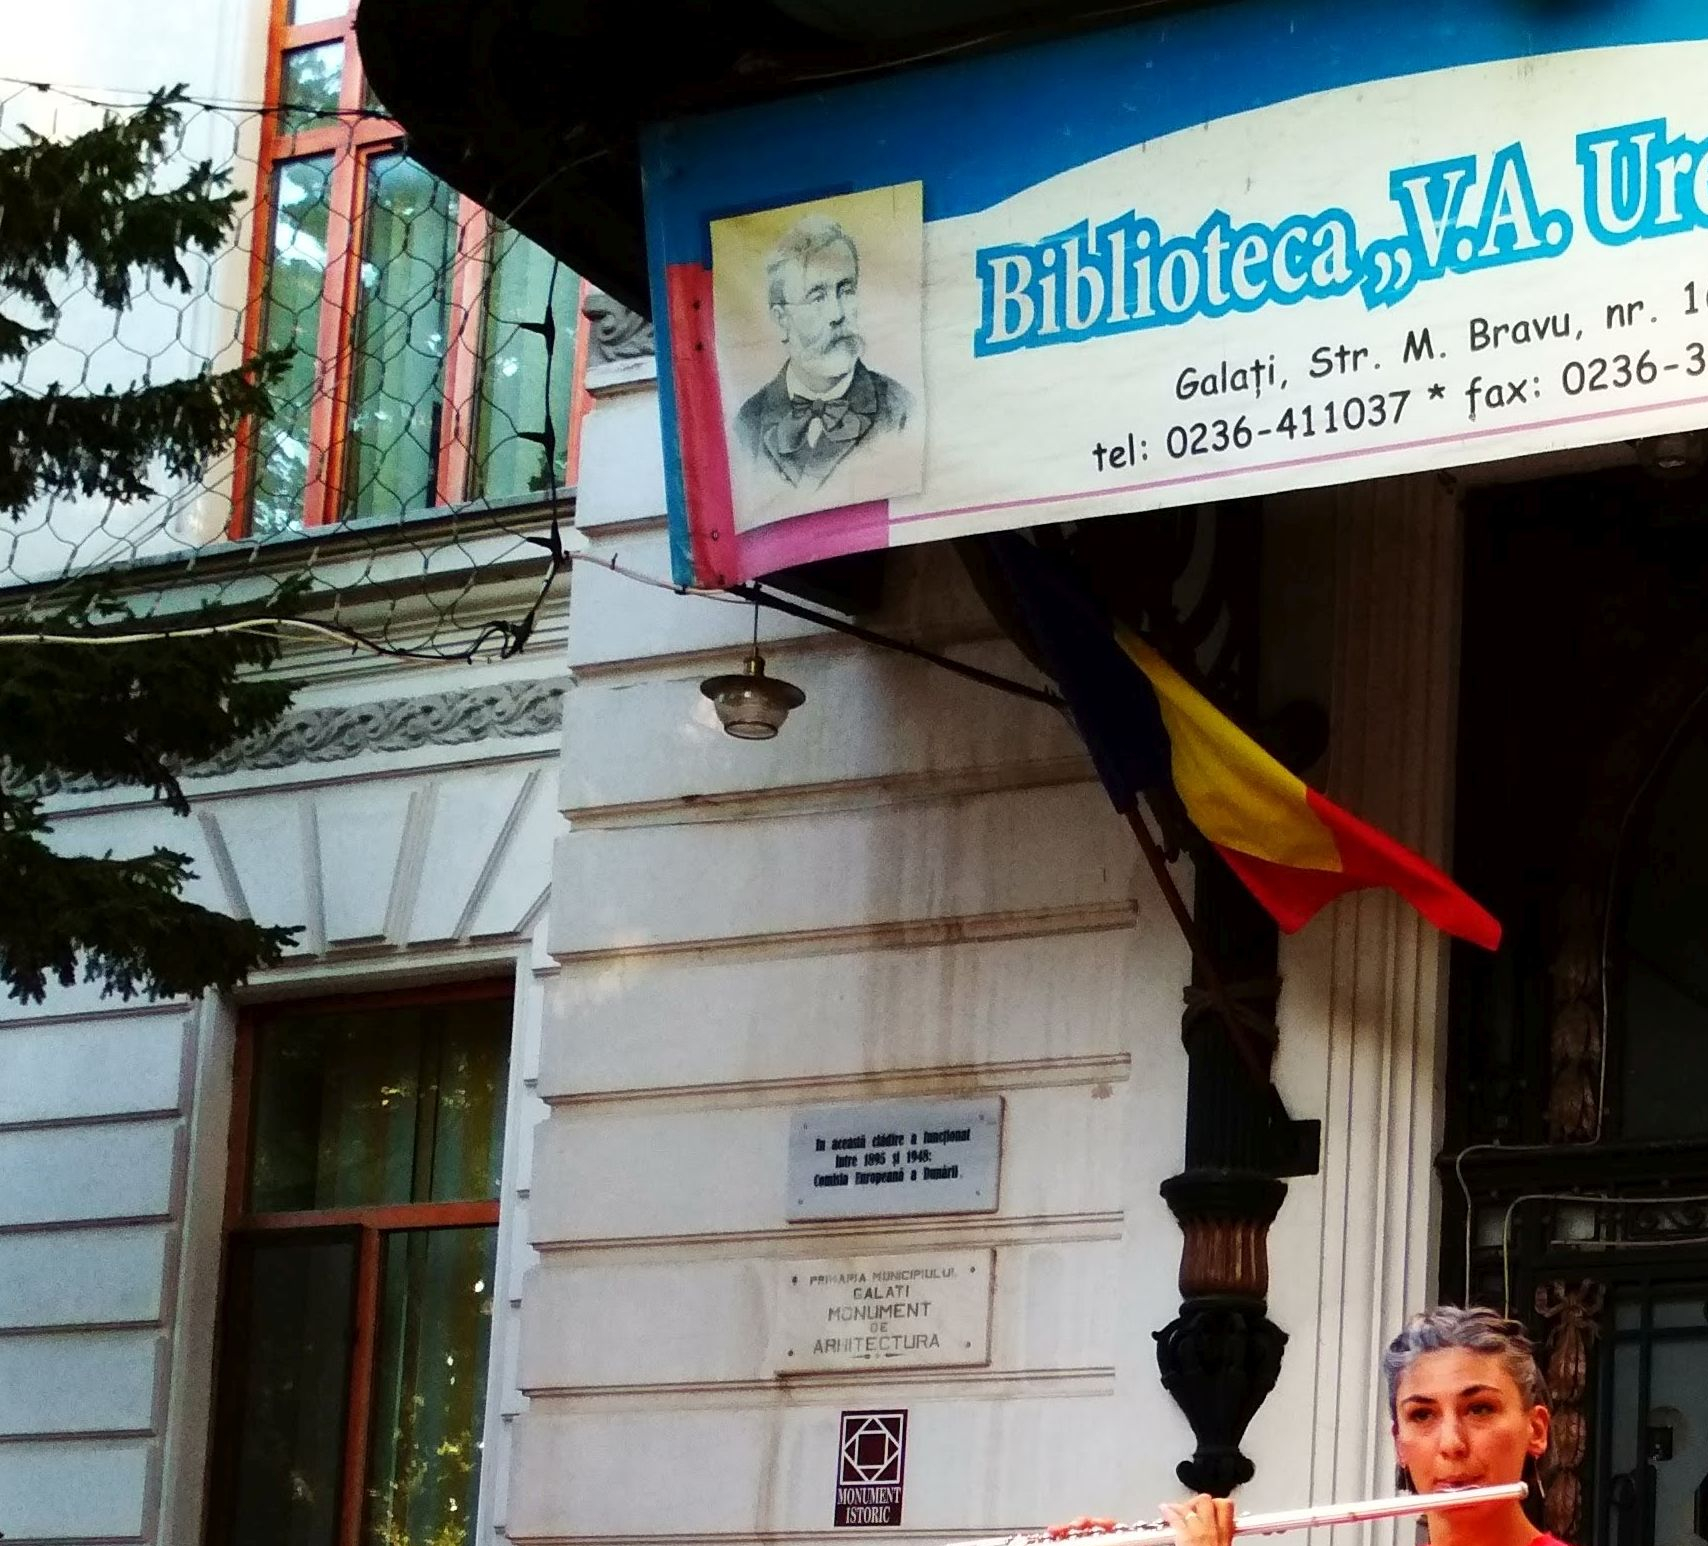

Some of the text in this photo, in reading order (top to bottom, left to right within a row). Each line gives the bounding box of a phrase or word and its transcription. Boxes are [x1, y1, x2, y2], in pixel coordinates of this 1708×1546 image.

[985, 218, 1355, 345] Biblioteca
[1308, 344, 1383, 380] Str.
[1402, 327, 1447, 363] M.
[1468, 310, 1584, 353] Bravu,
[1605, 298, 1659, 330] nr.
[1092, 432, 1149, 472] tel:
[1166, 389, 1411, 460] 0236-411037
[1464, 377, 1542, 414] fax:
[911, 1133, 917, 1145] a
[813, 1173, 849, 1187] Comisia
[911, 1169, 917, 1181] a
[853, 1284, 910, 1300] GALATI
[828, 1302, 932, 1321] MONUMENT
[869, 1322, 889, 1333] DE
[813, 1334, 940, 1354] ARHITECTURA
[837, 1486, 902, 1505] MONUMENT
[845, 1506, 891, 1524] ISTORIC
